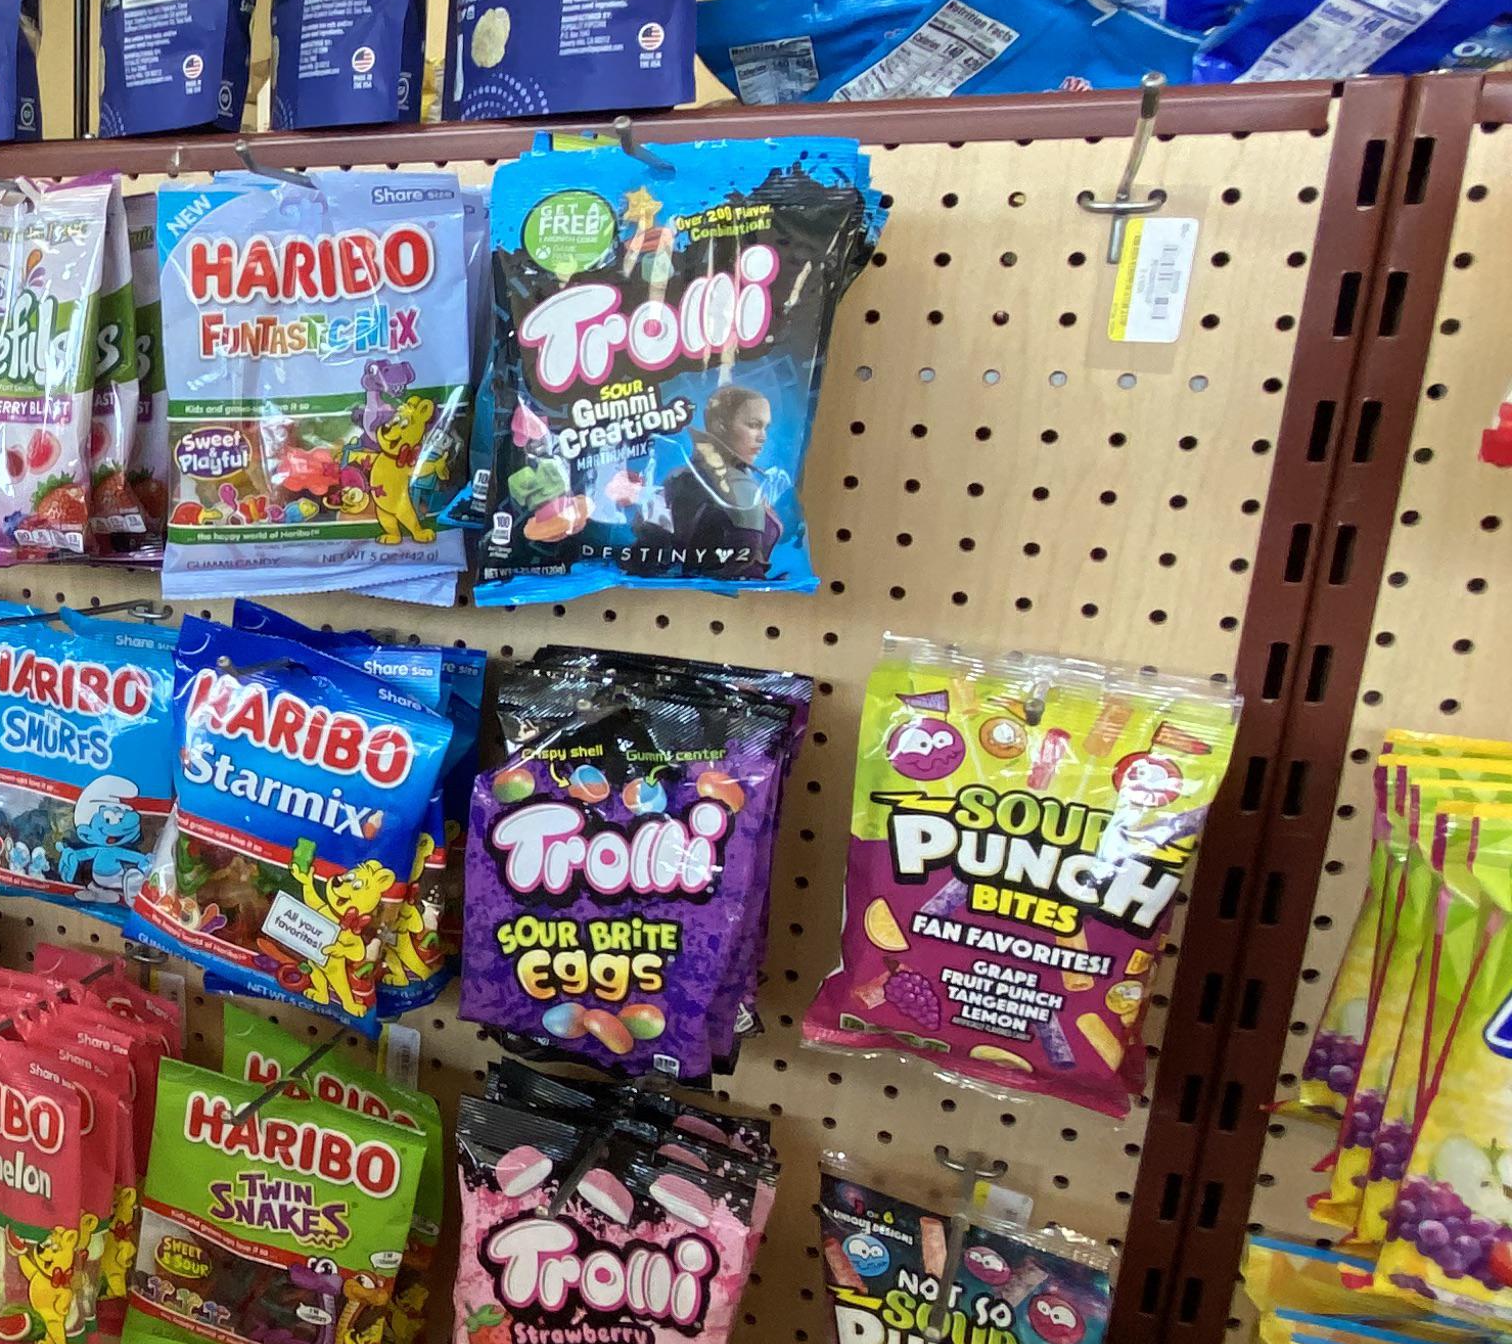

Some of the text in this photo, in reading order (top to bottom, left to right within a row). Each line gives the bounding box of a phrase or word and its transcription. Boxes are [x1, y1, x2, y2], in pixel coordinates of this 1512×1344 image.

[944, 0, 1016, 44] Nutrition Facts
[167, 194, 212, 237] NEW
[538, 215, 600, 236] FREE
[189, 227, 434, 302] HARIBO
[519, 244, 779, 392] Trolli
[572, 388, 658, 429] Gummi
[600, 379, 643, 401] SOUR
[180, 433, 242, 451] Sweet
[559, 400, 689, 459] Creations
[178, 451, 250, 480] Playful
[582, 544, 708, 561] DESTINY
[115, 634, 153, 649] Share
[363, 660, 434, 677] Share size
[3, 709, 112, 767] SMURFS
[188, 669, 413, 788] HARIBO
[522, 745, 603, 762] Crispy shell
[183, 742, 372, 840] Starmix
[492, 800, 727, 895] Trolli
[893, 813, 1181, 929] PUNCH
[283, 909, 324, 938] All your
[972, 883, 1079, 934] BITES
[274, 917, 324, 952] favorites!
[497, 916, 579, 954] SOUR
[912, 914, 1112, 976] FAN FAVORITES!
[941, 968, 1063, 1010] FRUIT PUNCH
[973, 960, 1038, 987] GRAPE
[947, 985, 1050, 1023] TANGERINE
[961, 1006, 1027, 1033] LEMON
[186, 1091, 401, 1199] HARIBO
[239, 1172, 314, 1206] TWIN
[209, 1181, 351, 1250] SNAKES
[163, 1235, 203, 1258] SWEET
[488, 1218, 710, 1325] Trolli
